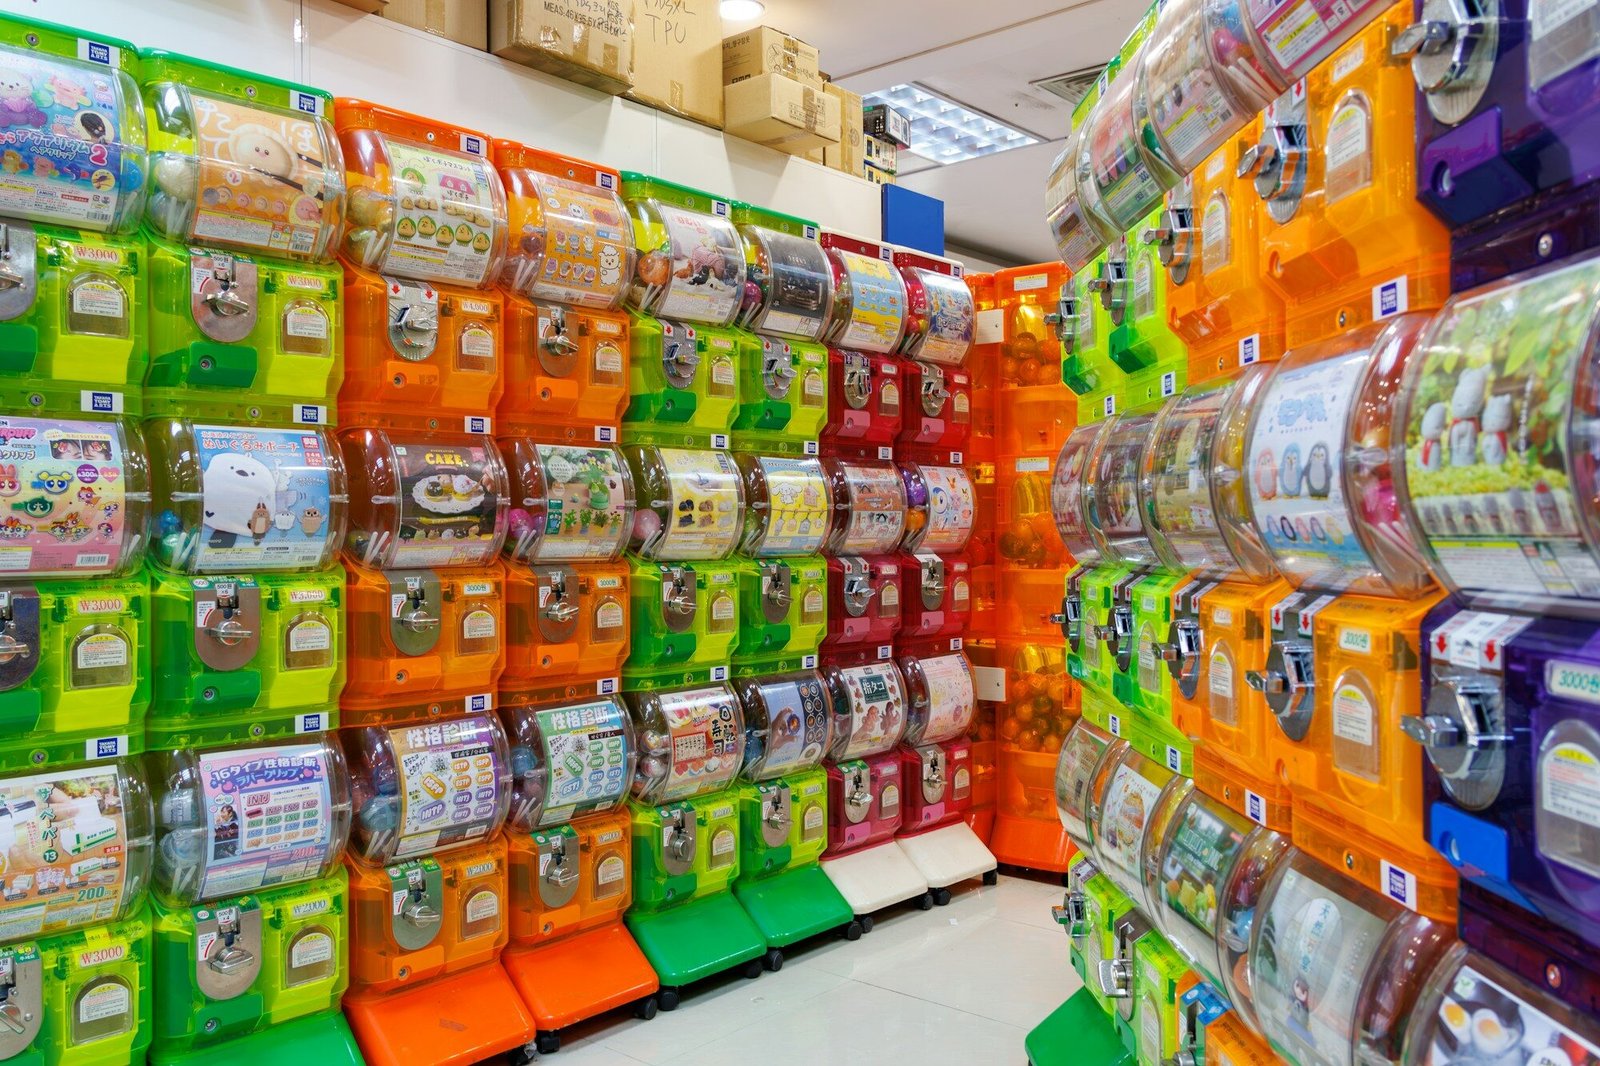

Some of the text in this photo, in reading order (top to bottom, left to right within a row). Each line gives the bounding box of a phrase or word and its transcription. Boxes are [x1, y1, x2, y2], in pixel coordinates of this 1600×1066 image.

[645, 13, 687, 46] TPU
[90, 143, 108, 166] 2
[203, 438, 300, 452] ぬいぐるみポーチ
[425, 453, 463, 465] CAKE
[863, 680, 886, 694] 指タコ
[551, 706, 609, 731] 性格診断
[406, 720, 477, 749] 性格診断
[212, 757, 316, 782] 16タイプ性格診断
[237, 769, 299, 787] ラバークリップ
[421, 804, 444, 821] INTP
[44, 852, 57, 861] 13
